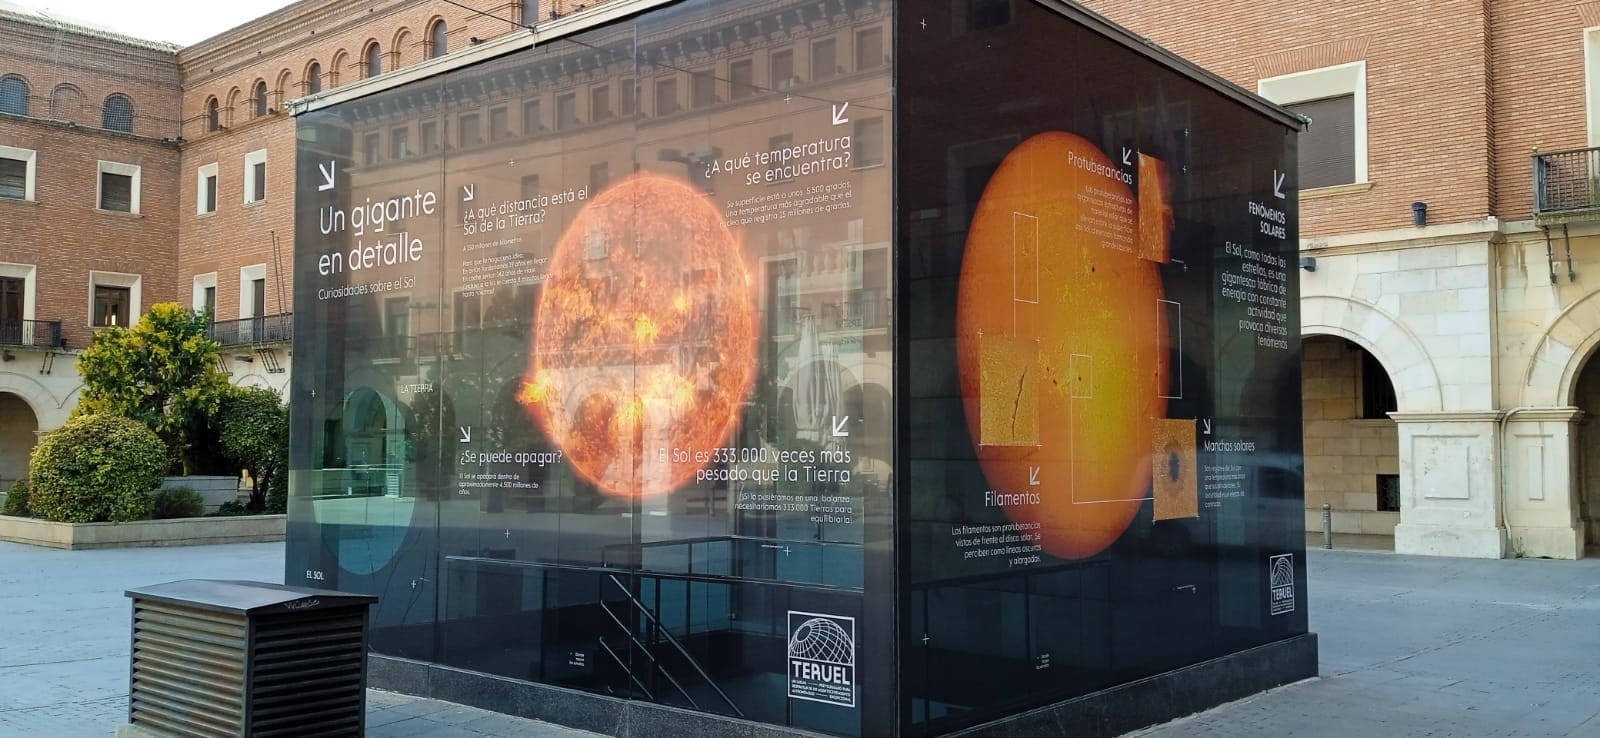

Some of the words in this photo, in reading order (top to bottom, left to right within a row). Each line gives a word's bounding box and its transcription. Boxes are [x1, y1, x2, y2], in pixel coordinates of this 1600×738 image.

[705, 160, 720, 178] ¿A
[724, 153, 750, 176] qué
[755, 136, 851, 165] temperatura
[746, 172, 760, 186] se
[766, 152, 851, 181] encuentra?
[1069, 152, 1132, 184] Protuberancias
[464, 208, 475, 223] ¿A
[478, 203, 496, 221] qué
[500, 195, 548, 214] distancia
[552, 188, 575, 204] está
[578, 184, 588, 202] el
[739, 202, 777, 215] temperatura
[794, 193, 828, 208] agradable
[845, 190, 852, 198] el
[788, 206, 813, 217] millones
[815, 205, 824, 213] de
[320, 206, 344, 234] Un
[351, 189, 436, 236] gigante
[1249, 202, 1285, 225] FENÓMENOS
[464, 221, 477, 235] Sol
[480, 219, 493, 232] de
[496, 218, 505, 230] la
[509, 210, 546, 227] Tierra?
[1260, 221, 1286, 239] SOLARES
[319, 252, 342, 275] en
[349, 232, 422, 270] detalle
[1226, 242, 1232, 254] El
[1244, 248, 1260, 261] como
[1222, 272, 1256, 288] gigantesca
[1279, 283, 1286, 295] de
[1275, 270, 1286, 282] una
[318, 283, 367, 300] Curiosidades
[370, 280, 392, 293] sobre
[394, 277, 401, 290] el
[404, 276, 416, 288] Sol
[1222, 286, 1246, 302] energía
[1247, 291, 1258, 302] con
[1248, 305, 1275, 320] actividad
[1276, 311, 1287, 323] que
[1239, 319, 1264, 332] provoca
[1204, 440, 1232, 452] Manchas
[1234, 440, 1255, 451] solares
[460, 450, 476, 465] ¿Se
[480, 449, 512, 466] puede
[515, 450, 562, 467] apagar?
[659, 448, 669, 463] El
[673, 448, 691, 463] Sol
[695, 451, 709, 463] es
[713, 448, 767, 463] 333.000
[772, 450, 815, 464] veces
[820, 448, 851, 464] más
[697, 466, 747, 485] pesado
[752, 469, 780, 486] que
[785, 466, 798, 482] la
[803, 466, 850, 483] Tierra
[985, 490, 1040, 507] Filamentos
[306, 571, 313, 579] EL
[314, 571, 324, 580] SOL
[1273, 586, 1292, 600] TERUEL
[792, 660, 850, 685] TERUEL
